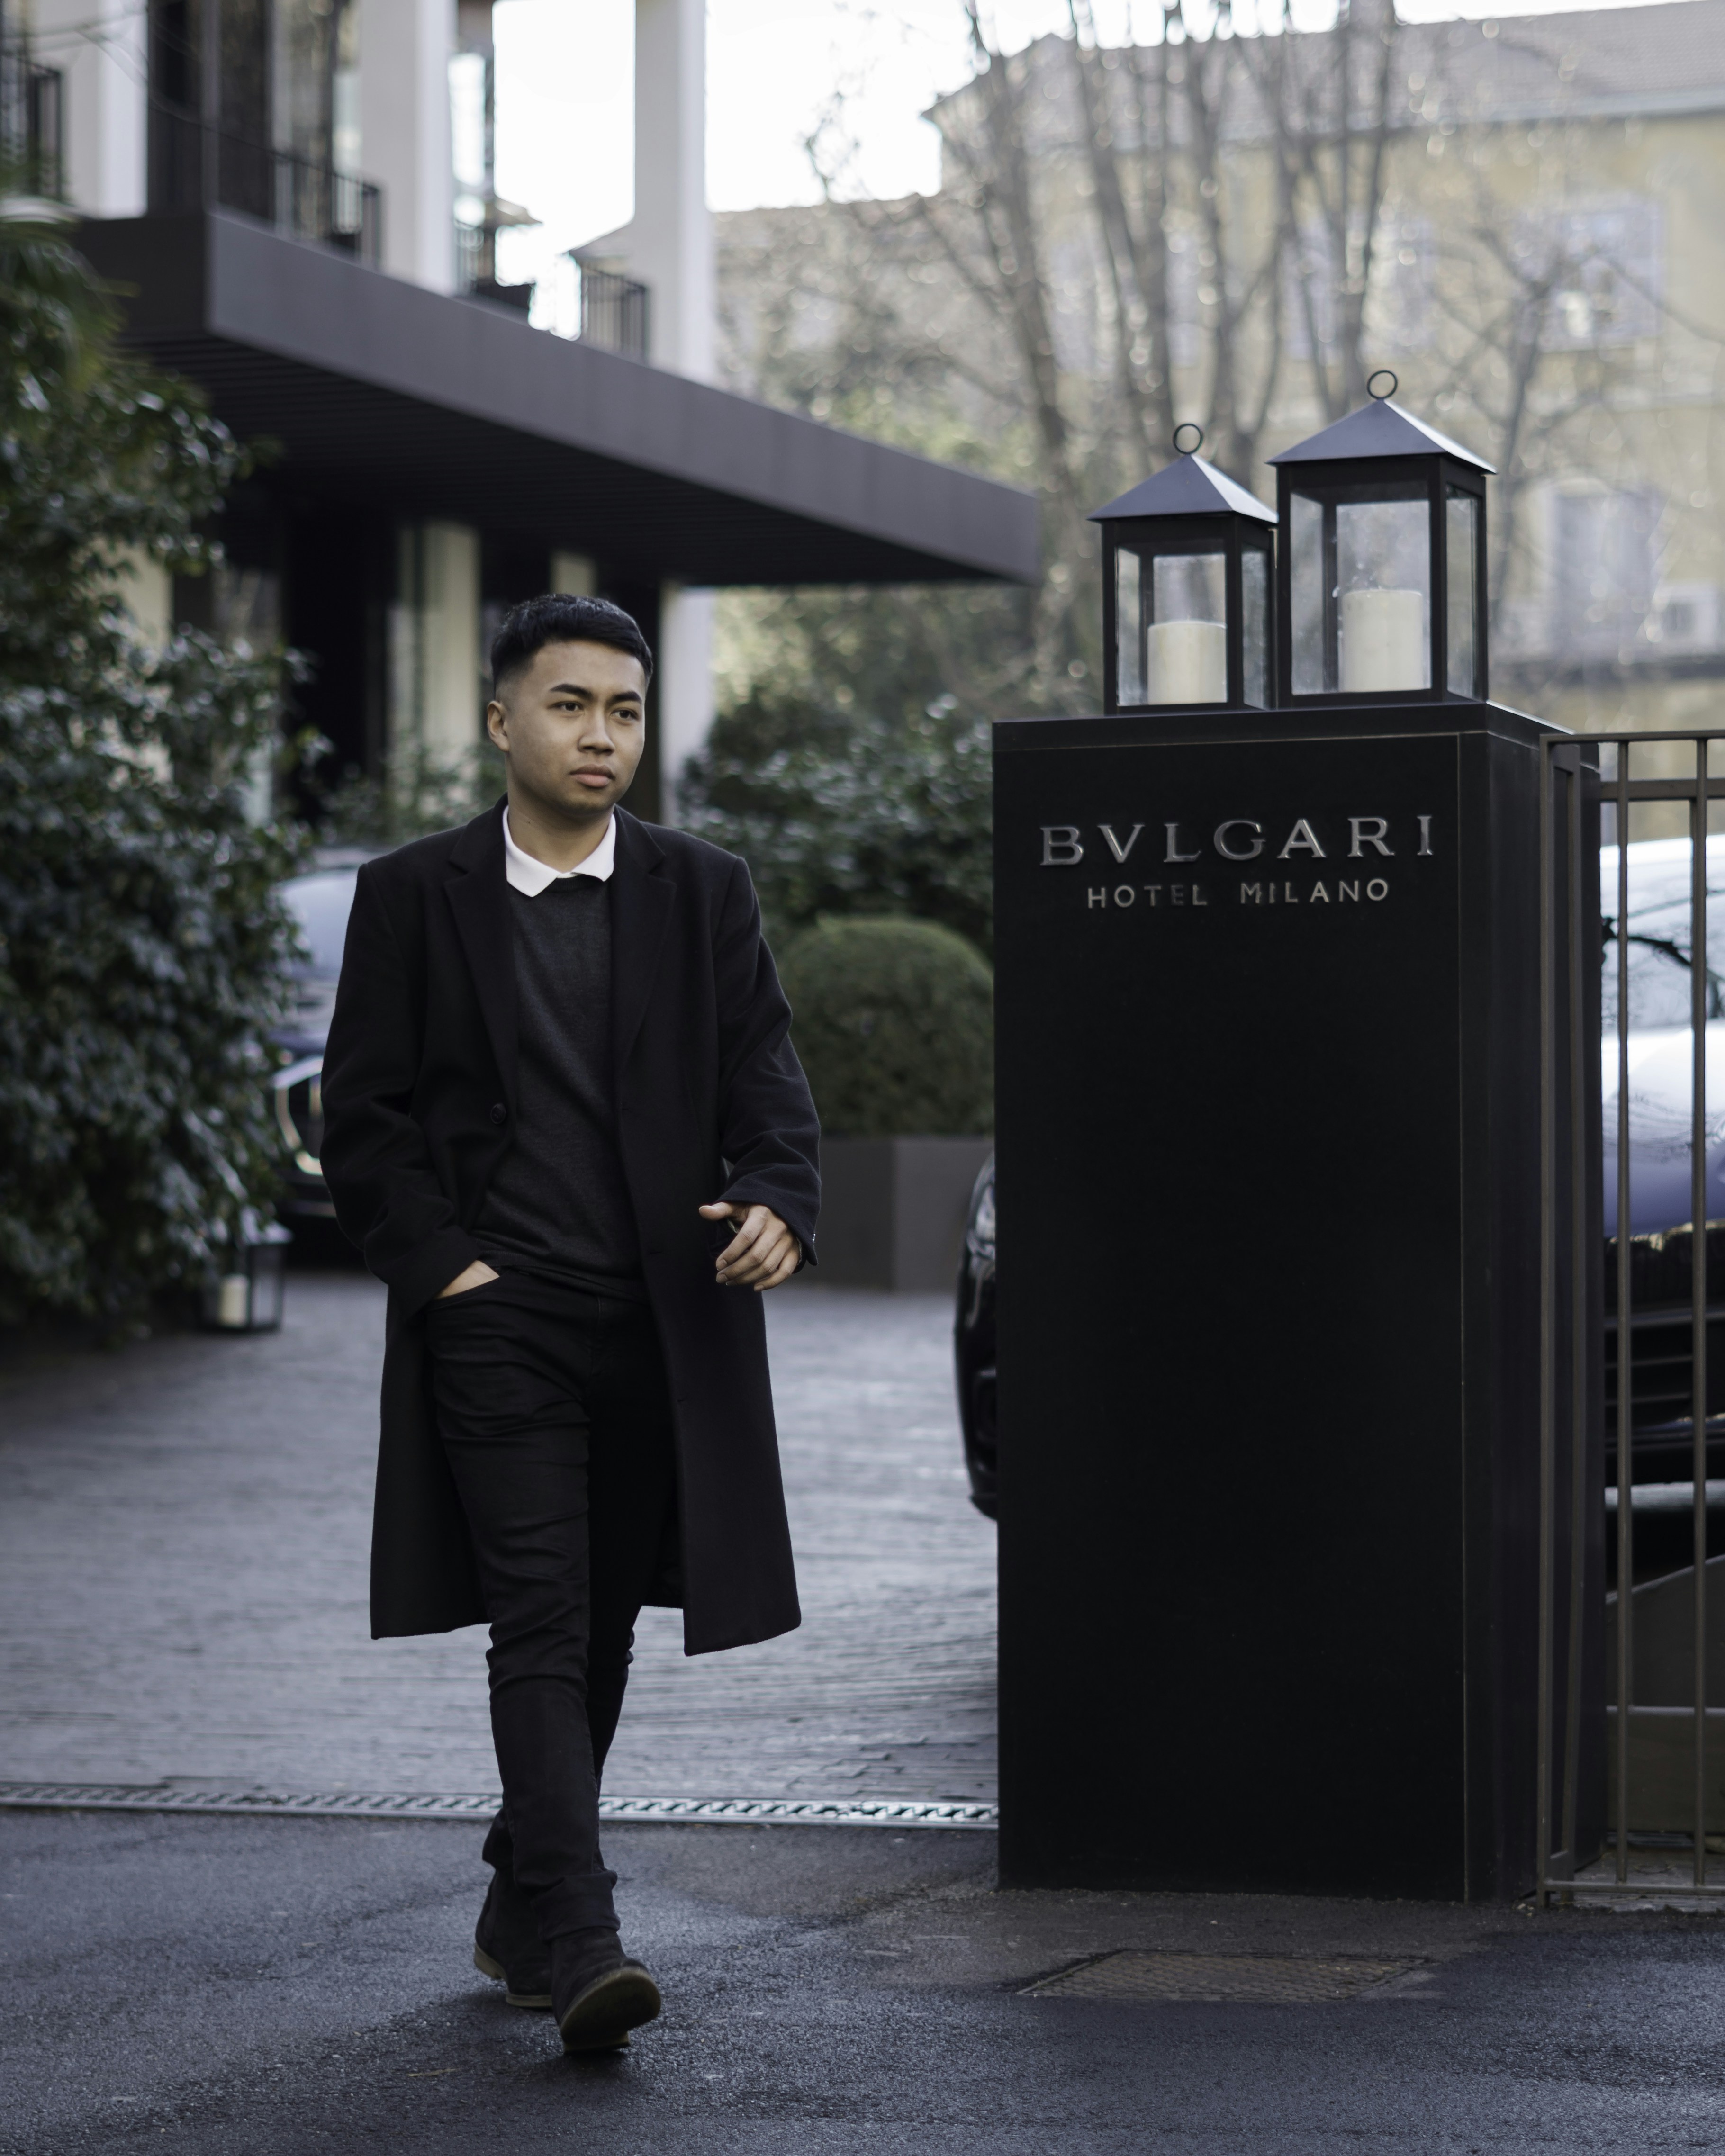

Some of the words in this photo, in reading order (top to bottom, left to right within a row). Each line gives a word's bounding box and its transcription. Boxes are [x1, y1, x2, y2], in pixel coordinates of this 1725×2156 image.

[1040, 815, 1433, 866] BVLGARI
[1087, 884, 1207, 908] HOTEL
[1240, 878, 1389, 904] MILANO
